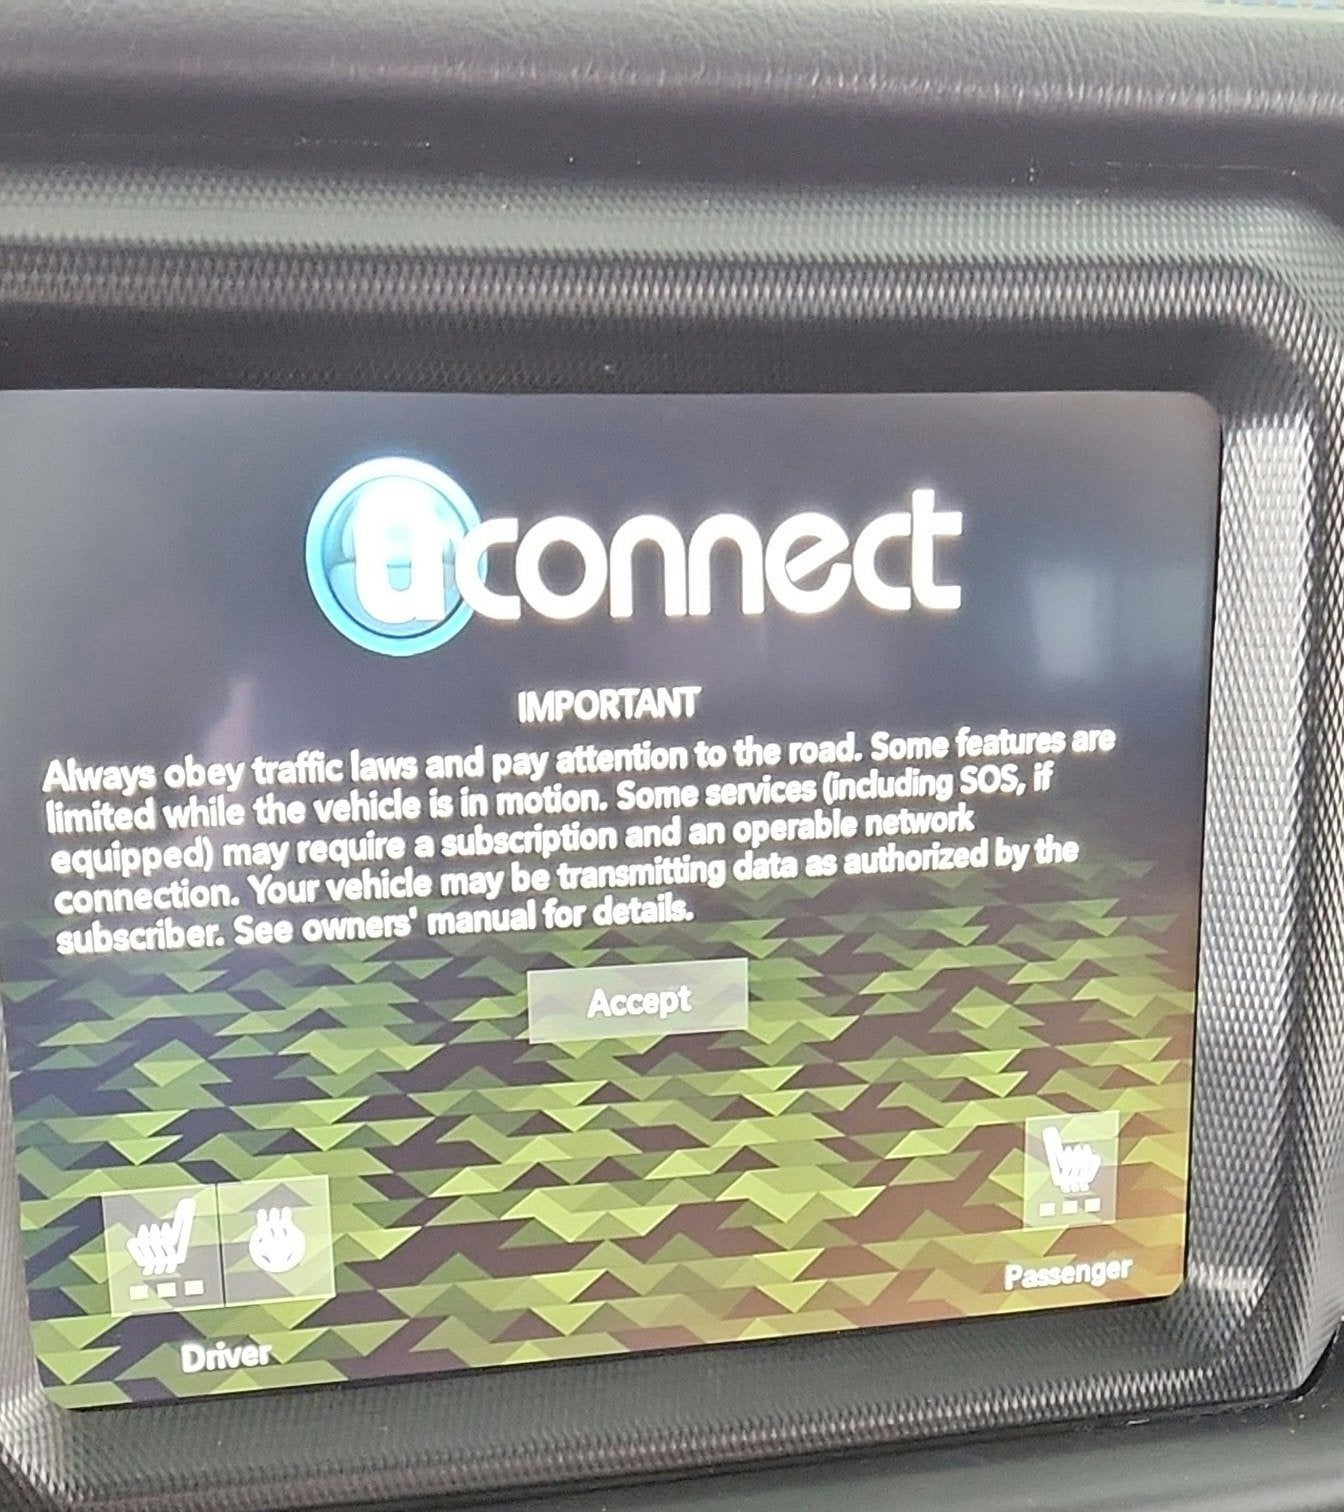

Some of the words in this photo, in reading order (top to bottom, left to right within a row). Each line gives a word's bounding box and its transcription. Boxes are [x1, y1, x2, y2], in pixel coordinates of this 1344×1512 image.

[518, 686, 702, 722] IMPORTANT
[42, 757, 156, 794] Always
[164, 756, 245, 791] obey
[252, 750, 343, 787] traffic
[351, 750, 418, 781] laws
[425, 746, 484, 779] and
[492, 747, 548, 781] pay
[556, 740, 688, 774] attention
[695, 741, 727, 769] to
[733, 735, 782, 767] the
[788, 732, 862, 766] road.
[870, 731, 949, 762] Some
[956, 727, 1066, 757] features
[1072, 725, 1116, 754] are
[45, 799, 155, 835] limited
[163, 795, 244, 829] while
[253, 792, 306, 826] the
[314, 788, 421, 824] vehicle
[428, 787, 454, 820] is
[459, 785, 488, 817] in
[495, 781, 607, 816] motion.
[616, 779, 698, 811] Some
[705, 775, 817, 807] services
[822, 766, 954, 806] (including
[959, 764, 1026, 797] SOS,
[1032, 762, 1055, 791] if
[51, 835, 213, 879] equipped)
[222, 839, 290, 871] may
[298, 833, 406, 867] require
[414, 834, 433, 858] a
[442, 824, 618, 861] subscription
[624, 815, 682, 848] and
[690, 817, 726, 846] an
[732, 810, 858, 847] operable
[865, 803, 974, 836] network
[54, 879, 239, 915] connection.
[247, 874, 319, 907] Your
[327, 865, 432, 902] vehicle
[441, 868, 503, 898] may
[511, 861, 549, 892] be
[557, 853, 726, 890] transmitting
[732, 850, 798, 882] data
[805, 852, 837, 877] as
[844, 838, 988, 876] authorized
[995, 837, 1029, 871] by
[1035, 834, 1079, 865] the
[56, 917, 224, 956] subscriber.
[233, 915, 292, 948] See
[302, 907, 420, 943] owners'
[427, 900, 537, 935] manual
[542, 898, 586, 929] for
[593, 893, 695, 926] details.
[587, 986, 692, 1019] Accept
[1004, 1258, 1133, 1290] Passenger
[181, 1341, 273, 1373] Driver
